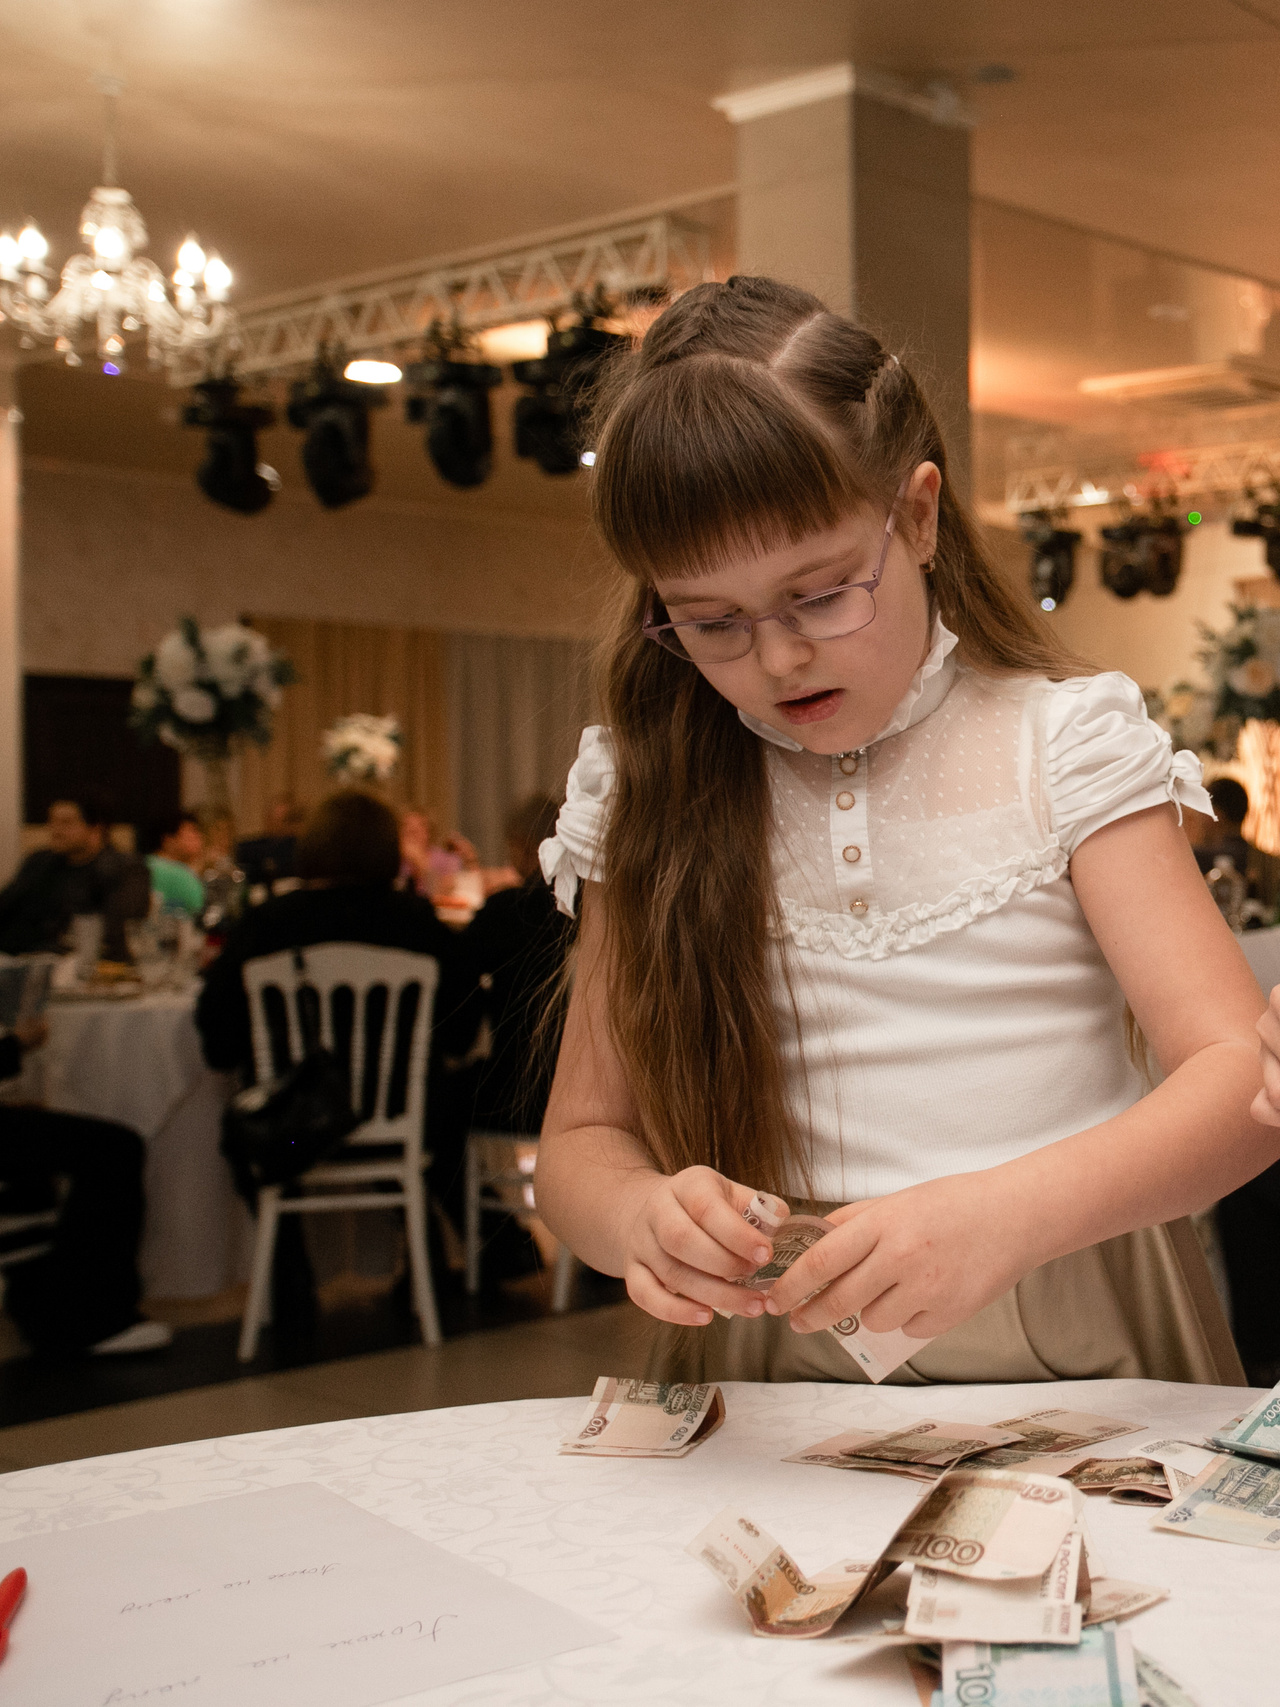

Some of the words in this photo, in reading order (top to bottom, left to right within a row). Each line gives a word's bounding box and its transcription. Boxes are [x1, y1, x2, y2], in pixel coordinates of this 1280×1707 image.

[582, 1416, 604, 1438] 100
[670, 1426, 689, 1442] СТО
[683, 1385, 710, 1425] РУБЛЕ
[1021, 1484, 1061, 1501] 100
[910, 1534, 985, 1566] 100
[775, 1554, 817, 1595] 100
[956, 1663, 996, 1707] 10
